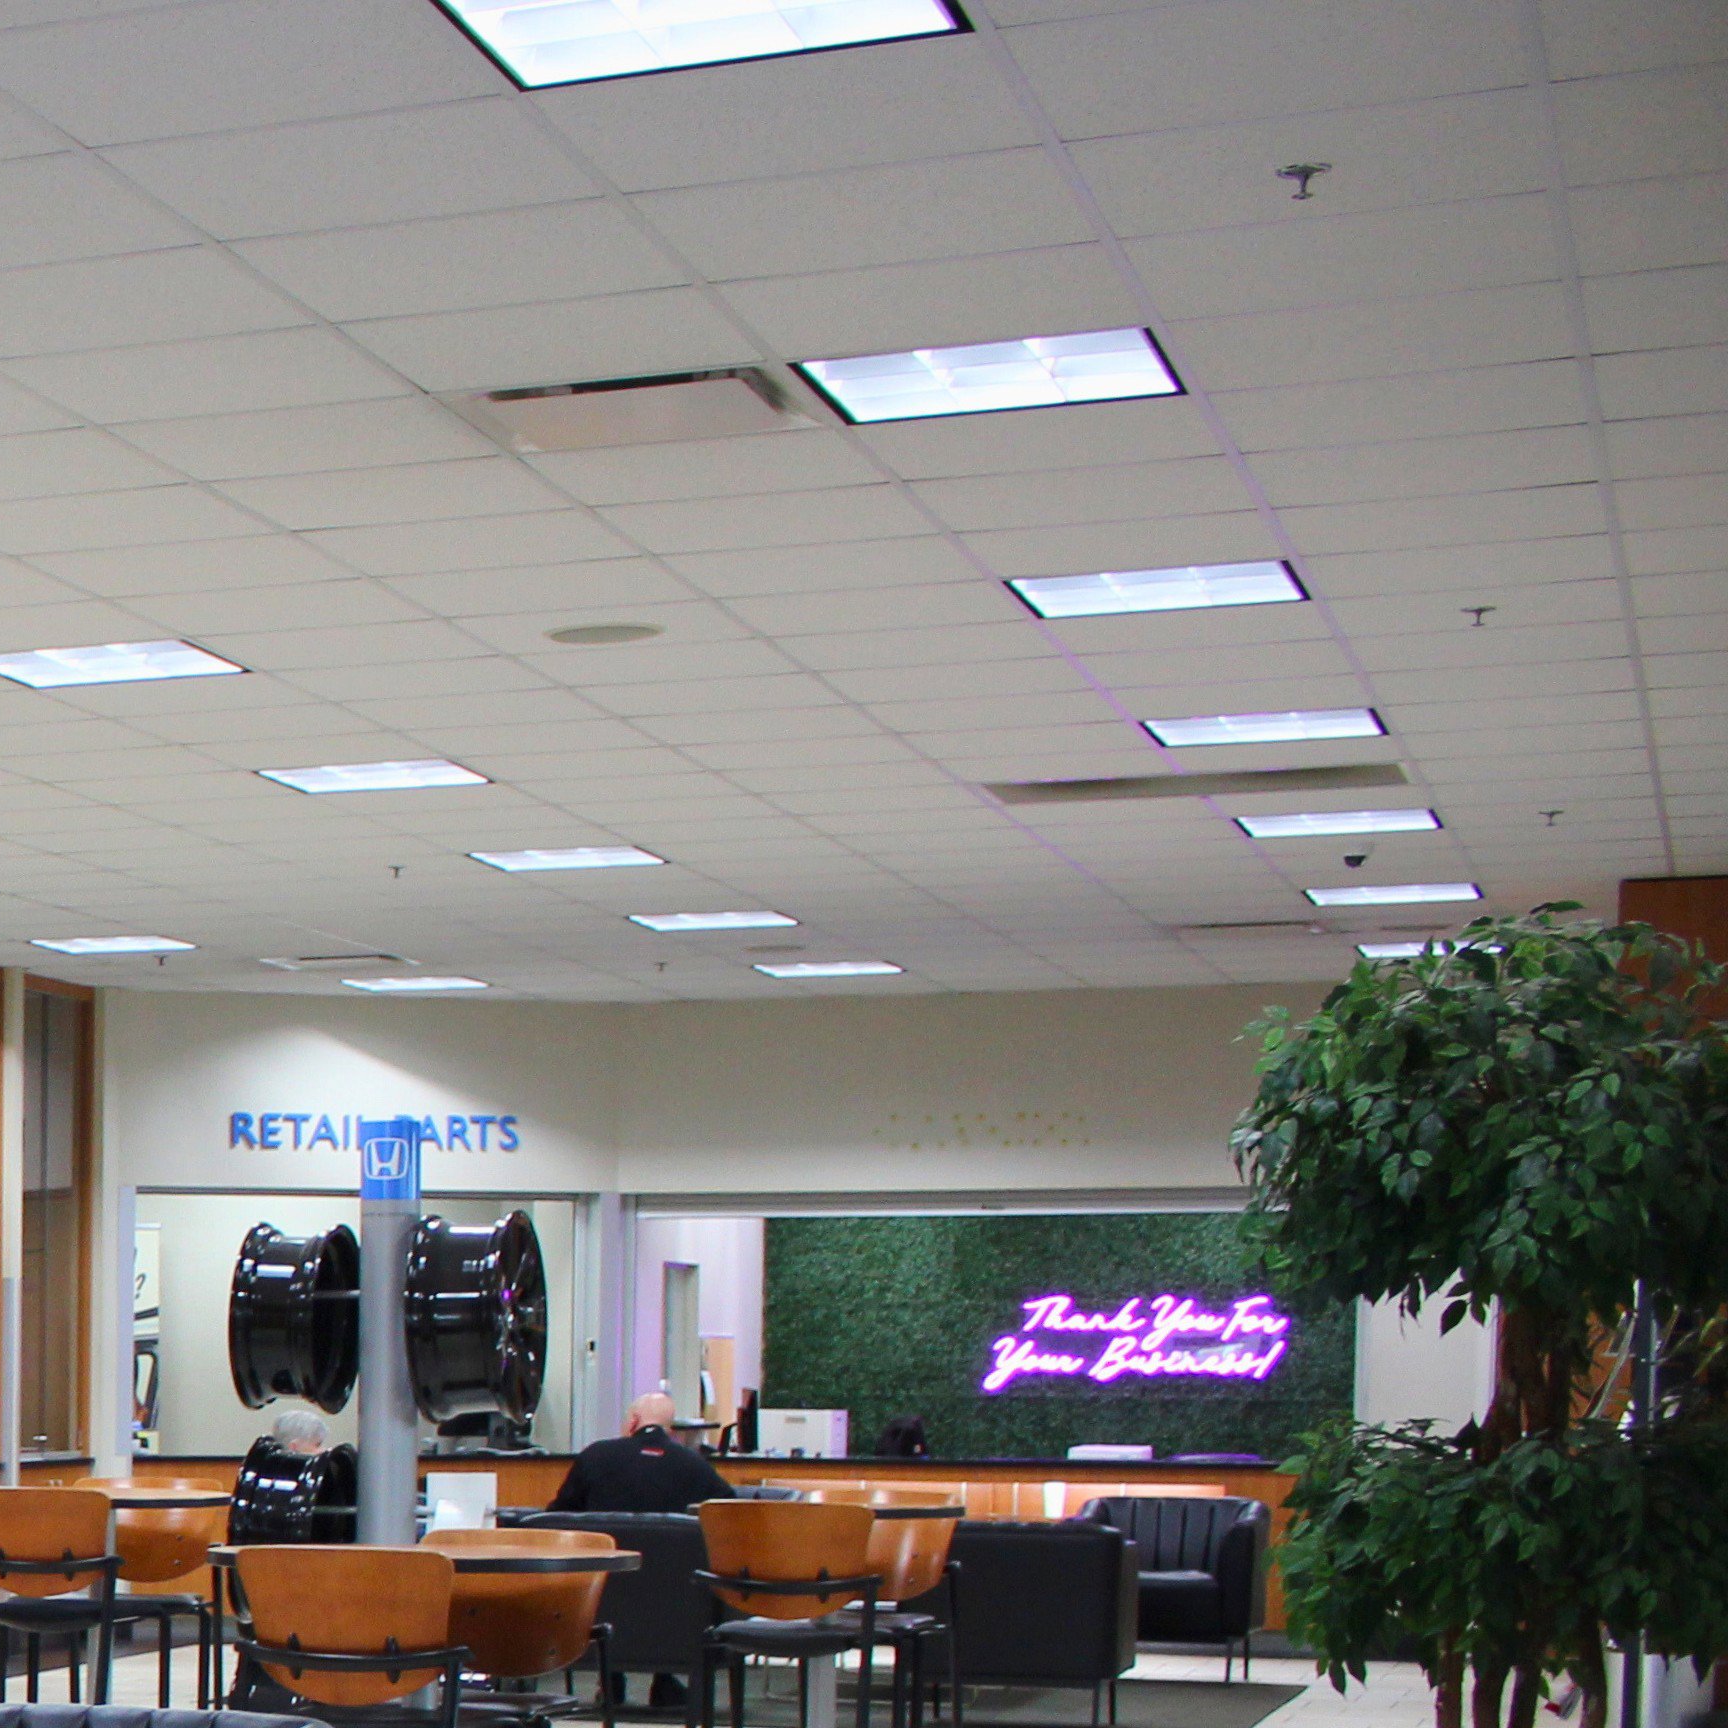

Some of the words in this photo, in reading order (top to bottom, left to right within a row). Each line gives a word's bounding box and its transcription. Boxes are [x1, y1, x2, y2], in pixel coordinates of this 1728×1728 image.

[394, 1112, 521, 1152] ARTS
[1021, 1294, 1147, 1332] Thank
[1139, 1293, 1228, 1352] You
[1219, 1295, 1290, 1342] For
[981, 1336, 1086, 1392] Your
[1086, 1336, 1287, 1382] Business!
